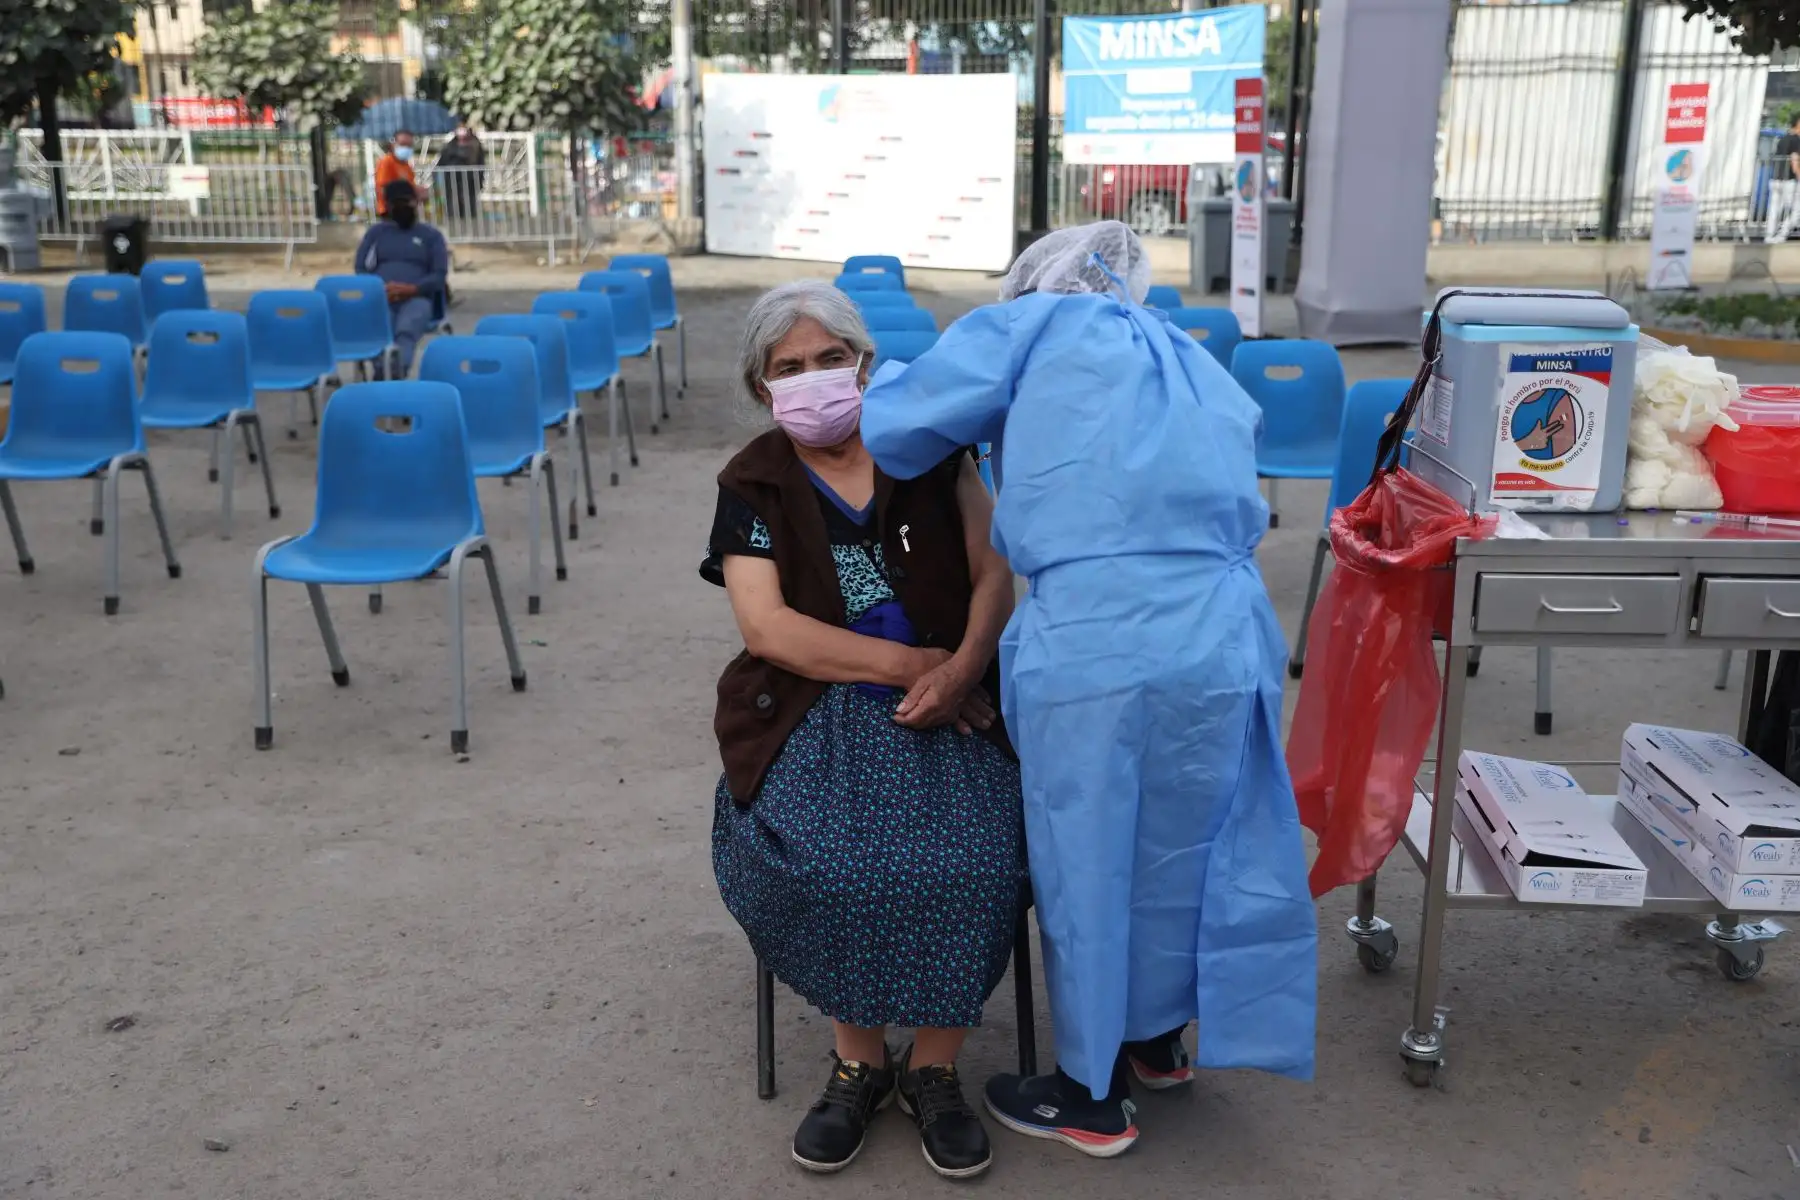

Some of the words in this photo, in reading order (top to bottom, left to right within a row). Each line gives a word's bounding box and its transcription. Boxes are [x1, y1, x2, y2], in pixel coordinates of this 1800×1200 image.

[1099, 16, 1222, 60] MINSA
[1536, 361, 1573, 371] MINSA
[1538, 377, 1553, 389] por
[1555, 377, 1564, 386] el
[1563, 378, 1583, 396] Perú
[1508, 381, 1538, 407] hombro
[1505, 404, 1512, 415] el
[1500, 416, 1510, 442] Pongo
[1565, 448, 1584, 464] contra
[1584, 411, 1595, 441] COVID-19
[1753, 851, 1783, 862] Wealy
[1532, 879, 1562, 890] Wealy
[1743, 887, 1771, 898] Wealy
